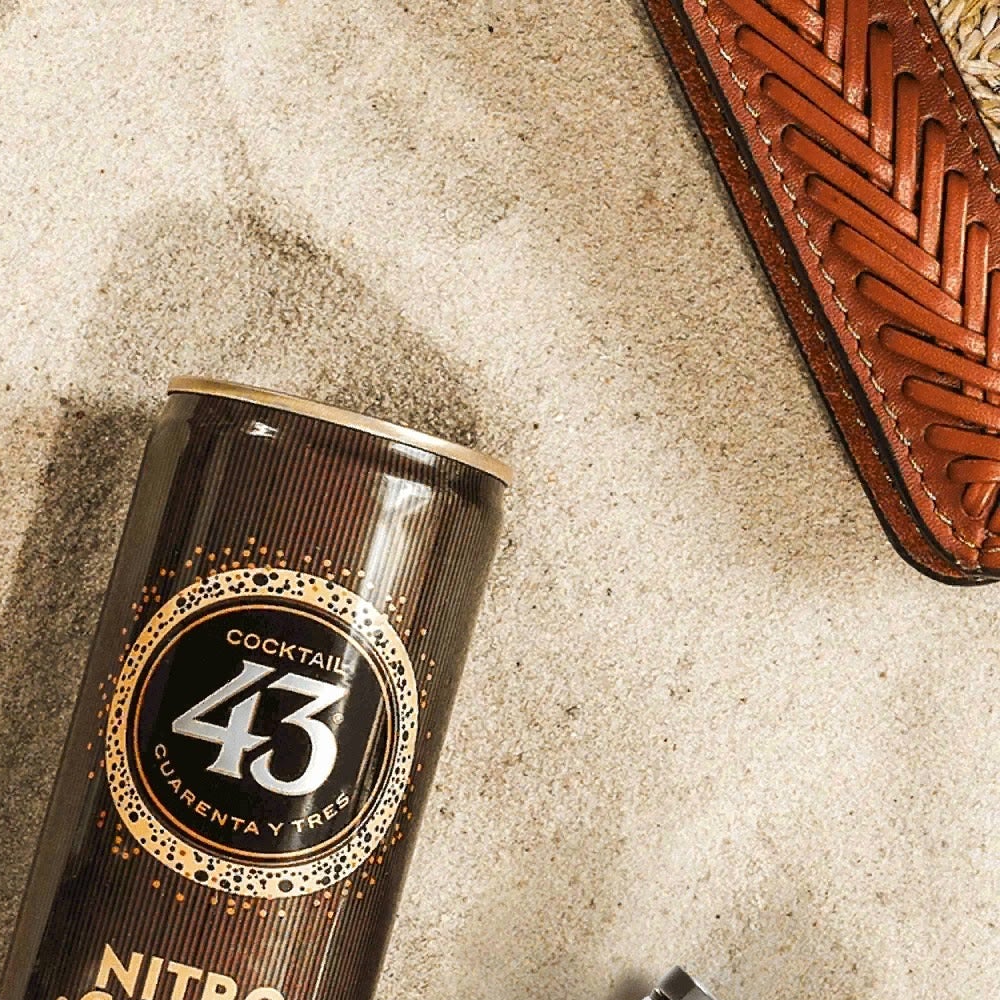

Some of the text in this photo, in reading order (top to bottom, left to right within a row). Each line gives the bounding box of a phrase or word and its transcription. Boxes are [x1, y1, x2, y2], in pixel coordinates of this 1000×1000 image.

[226, 628, 348, 675] COCKTAIL
[171, 659, 349, 796] 43
[154, 743, 350, 837] CUARENTA Y TRES
